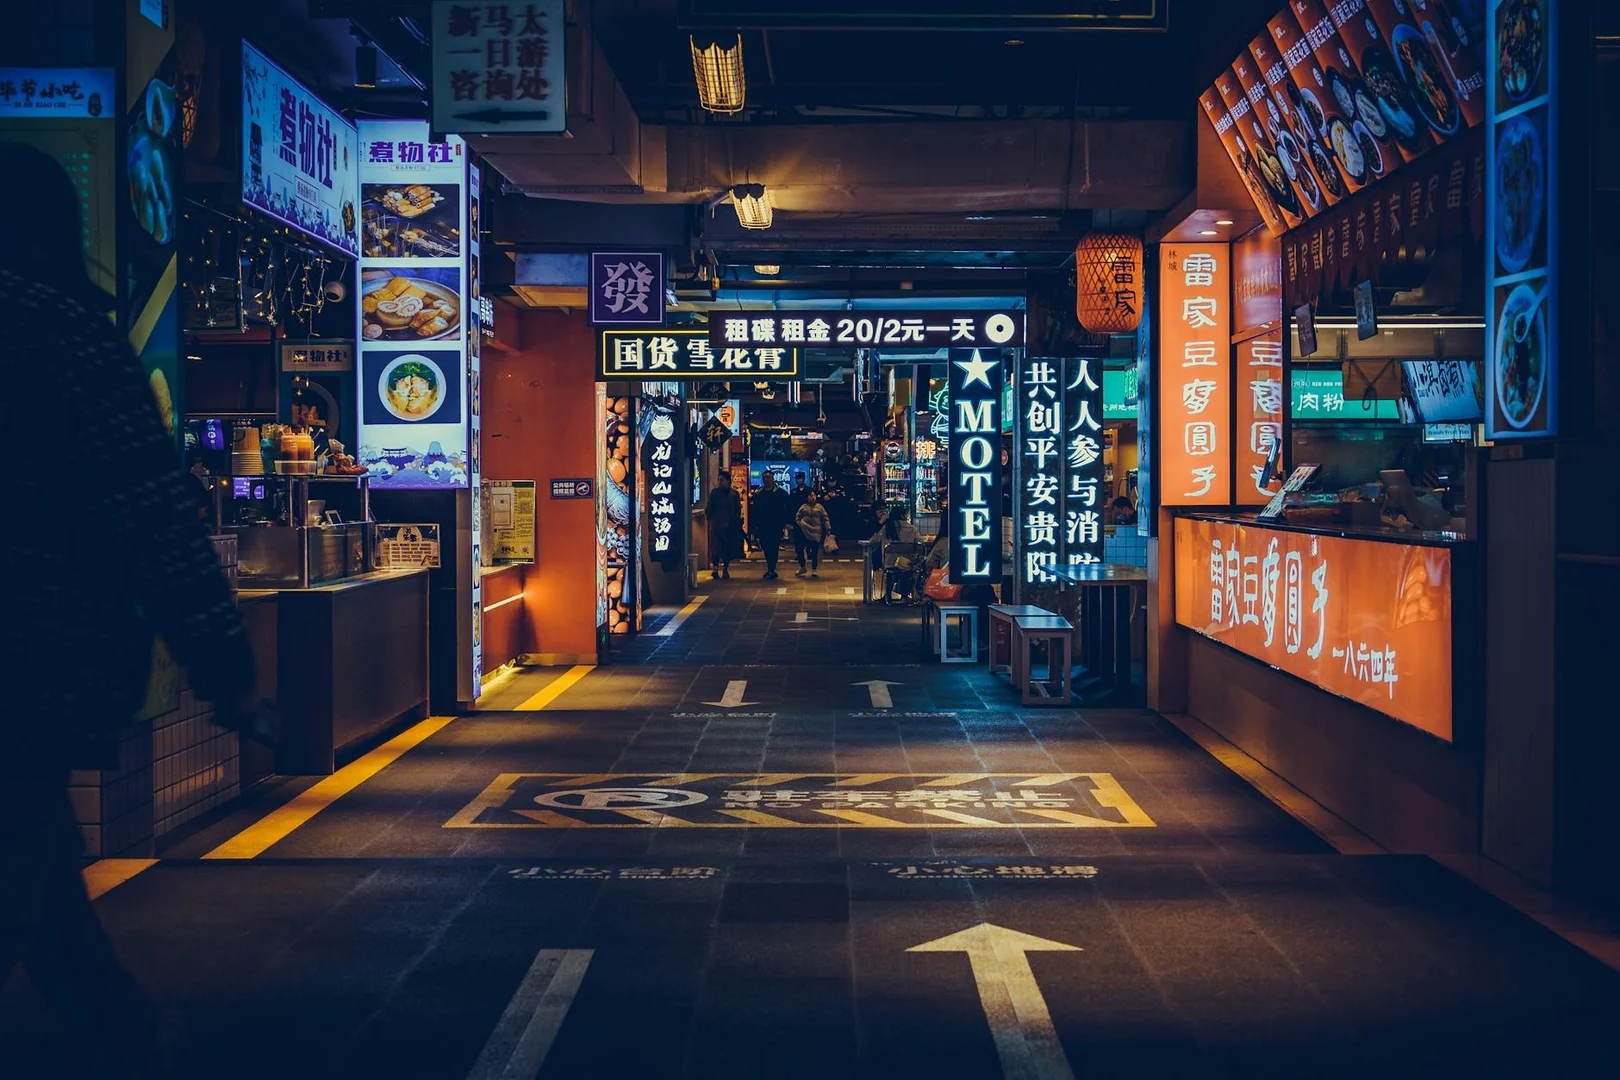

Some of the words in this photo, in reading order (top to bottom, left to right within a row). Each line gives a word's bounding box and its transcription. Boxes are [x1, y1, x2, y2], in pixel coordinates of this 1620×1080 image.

[447, 4, 548, 37] 新马太
[446, 38, 548, 69] 一日游
[449, 69, 550, 101] 咨询处
[280, 87, 333, 189] 煮物社
[369, 141, 453, 163] 煮物社
[601, 261, 655, 314] 發
[1112, 256, 1136, 317] 雷家
[725, 318, 776, 343] 租碟
[781, 318, 830, 342] 租金
[837, 318, 975, 343] 20/2元一天
[614, 336, 669, 370] 国货
[687, 338, 786, 370] 雪花膏
[1291, 392, 1345, 412] 肉粉
[954, 399, 998, 577] MOTEL
[1023, 362, 1062, 583] 共创平安贵阳
[1332, 640, 1399, 700] 一八六四年
[721, 789, 1074, 802] 驻车禁止
